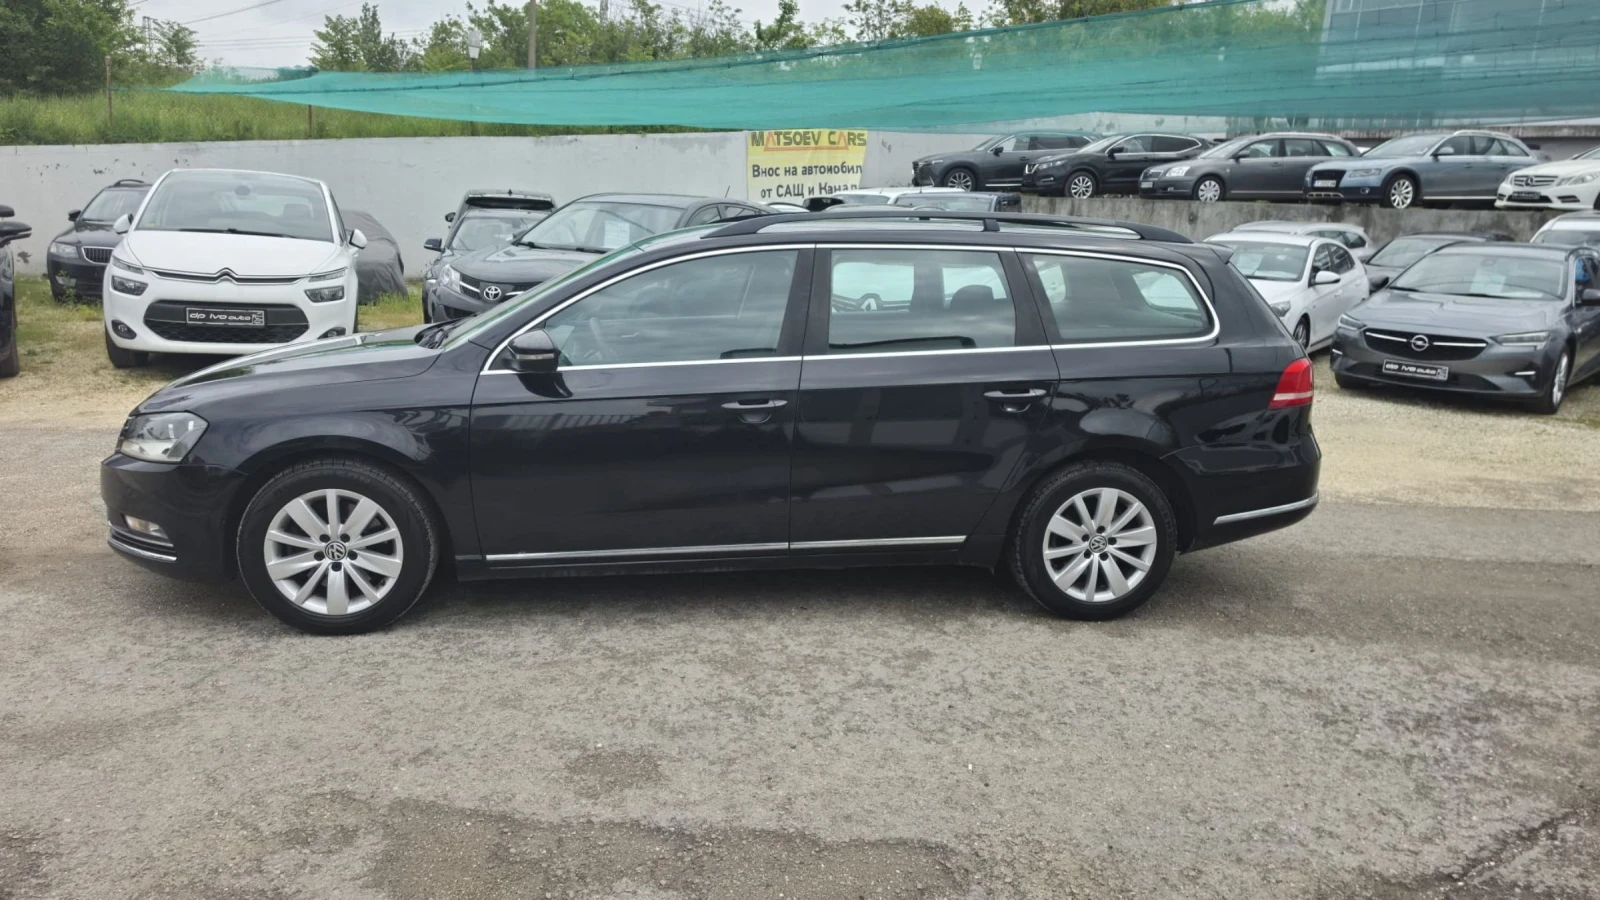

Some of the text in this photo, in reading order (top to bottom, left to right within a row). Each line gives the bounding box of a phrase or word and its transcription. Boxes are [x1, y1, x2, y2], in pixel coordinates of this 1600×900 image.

[751, 131, 867, 147] MATSOEV CARS
[752, 164, 780, 178] Внос
[784, 165, 798, 176] на
[760, 188, 773, 198] от
[776, 183, 804, 199] САЩ
[808, 186, 815, 196] и
